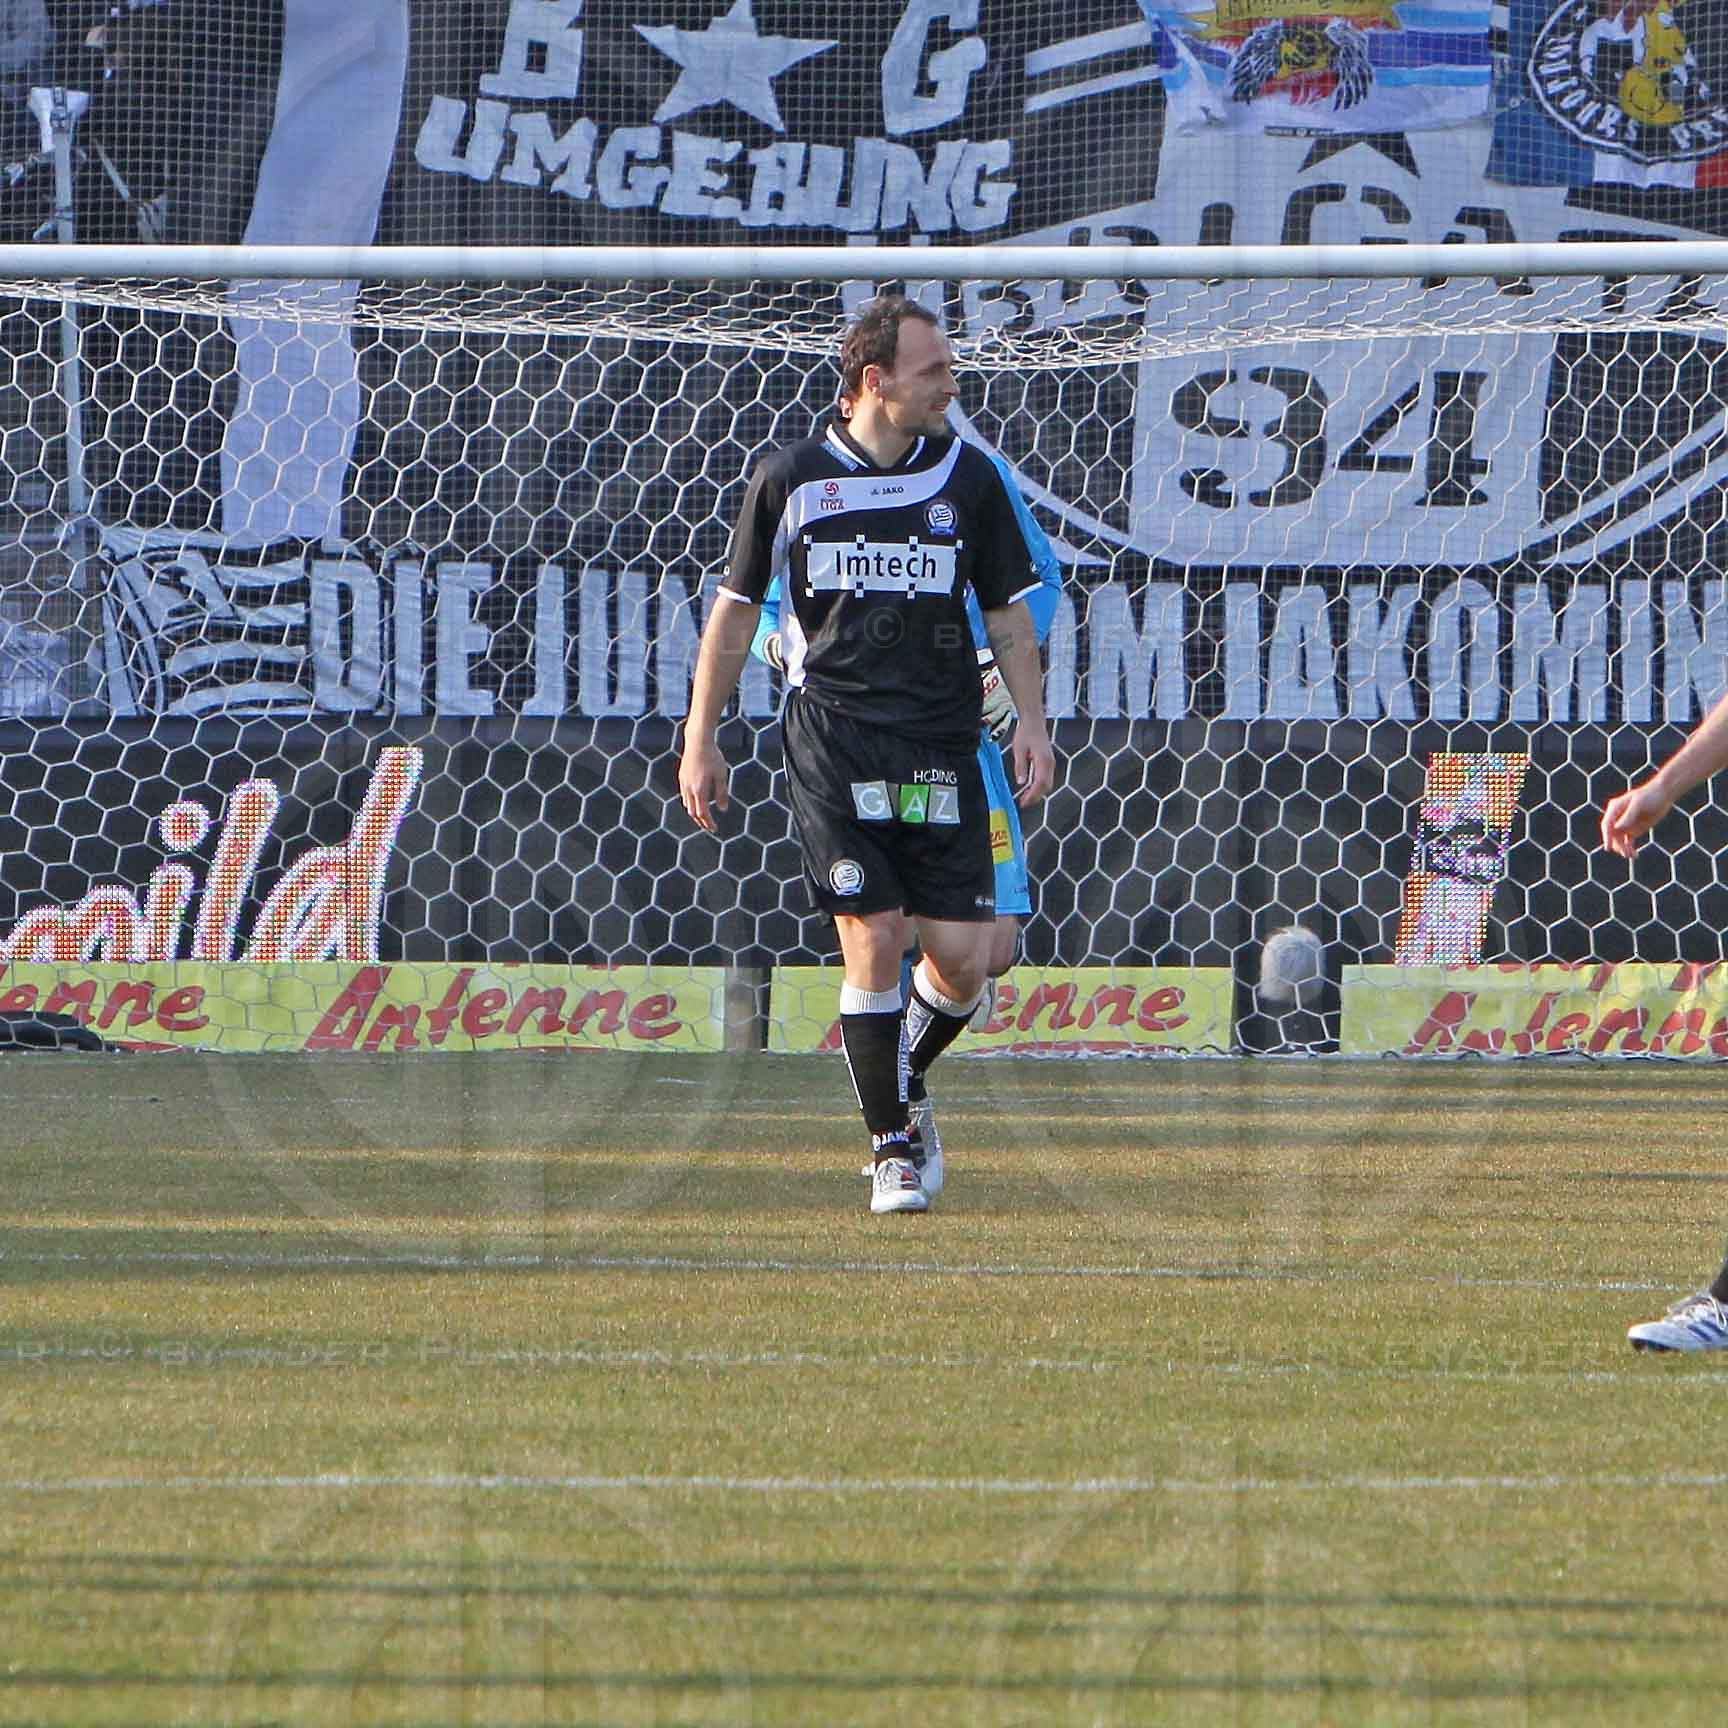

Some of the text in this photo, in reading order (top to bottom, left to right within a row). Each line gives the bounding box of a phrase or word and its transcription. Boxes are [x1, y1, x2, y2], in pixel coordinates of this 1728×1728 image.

[414, 94, 1018, 233] UMGEBUNG
[835, 549, 938, 580] Imtech
[310, 559, 496, 716] DIE
[303, 965, 684, 1053] Antenne
